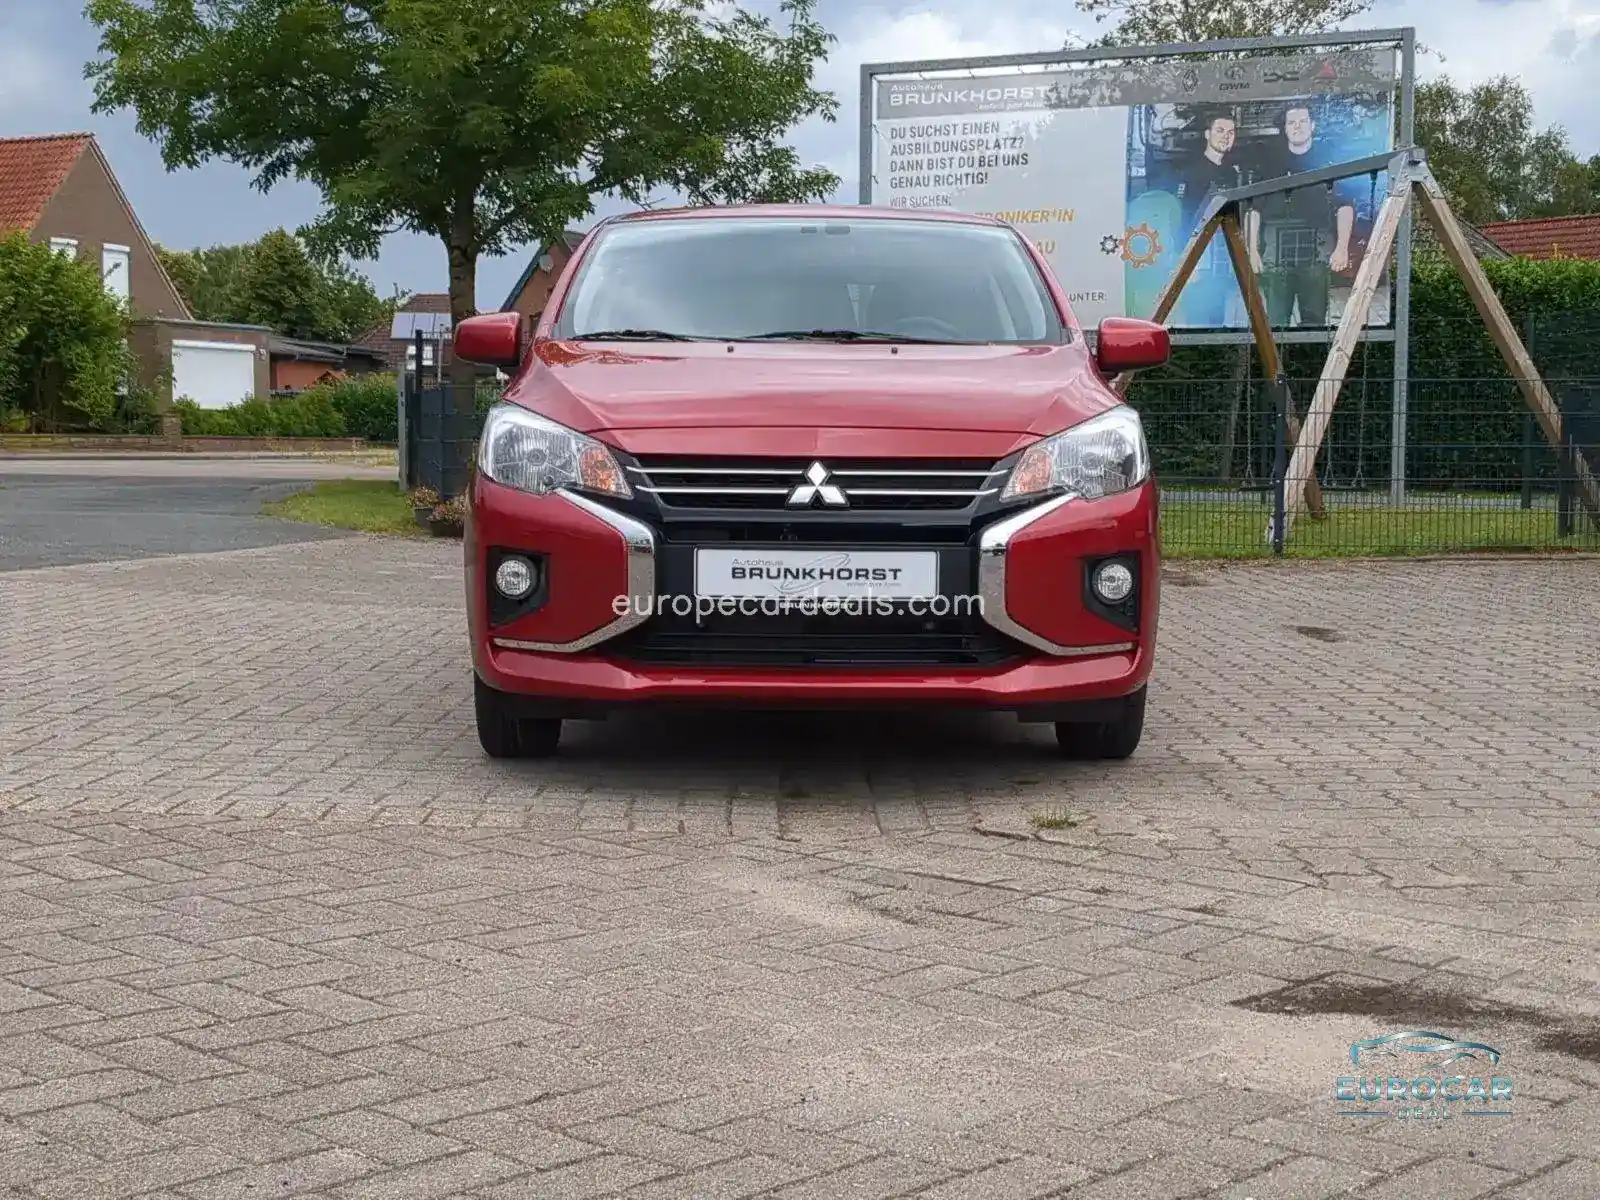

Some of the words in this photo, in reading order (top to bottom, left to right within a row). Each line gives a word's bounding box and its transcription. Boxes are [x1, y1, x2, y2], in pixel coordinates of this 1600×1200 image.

[890, 87, 1048, 106] BRUNKHORST
[890, 127, 906, 139] DU
[909, 124, 959, 138] SUCHST
[962, 121, 999, 135] EINEN
[890, 136, 1024, 156] AUSBILDUNGSPLATZ?
[890, 159, 924, 172] DANN
[927, 157, 956, 170] BIST
[958, 155, 975, 169] DU
[978, 154, 999, 168] BEI
[1002, 153, 1029, 167] UNS
[890, 174, 931, 189] GENAU
[934, 171, 988, 187] RICHTIG!
[890, 196, 907, 207] WIR
[909, 194, 951, 208] SUCHEN:
[1069, 292, 1107, 303] UNTER:
[731, 558, 784, 566] Autohaus
[731, 567, 902, 581] BRUNKHORST
